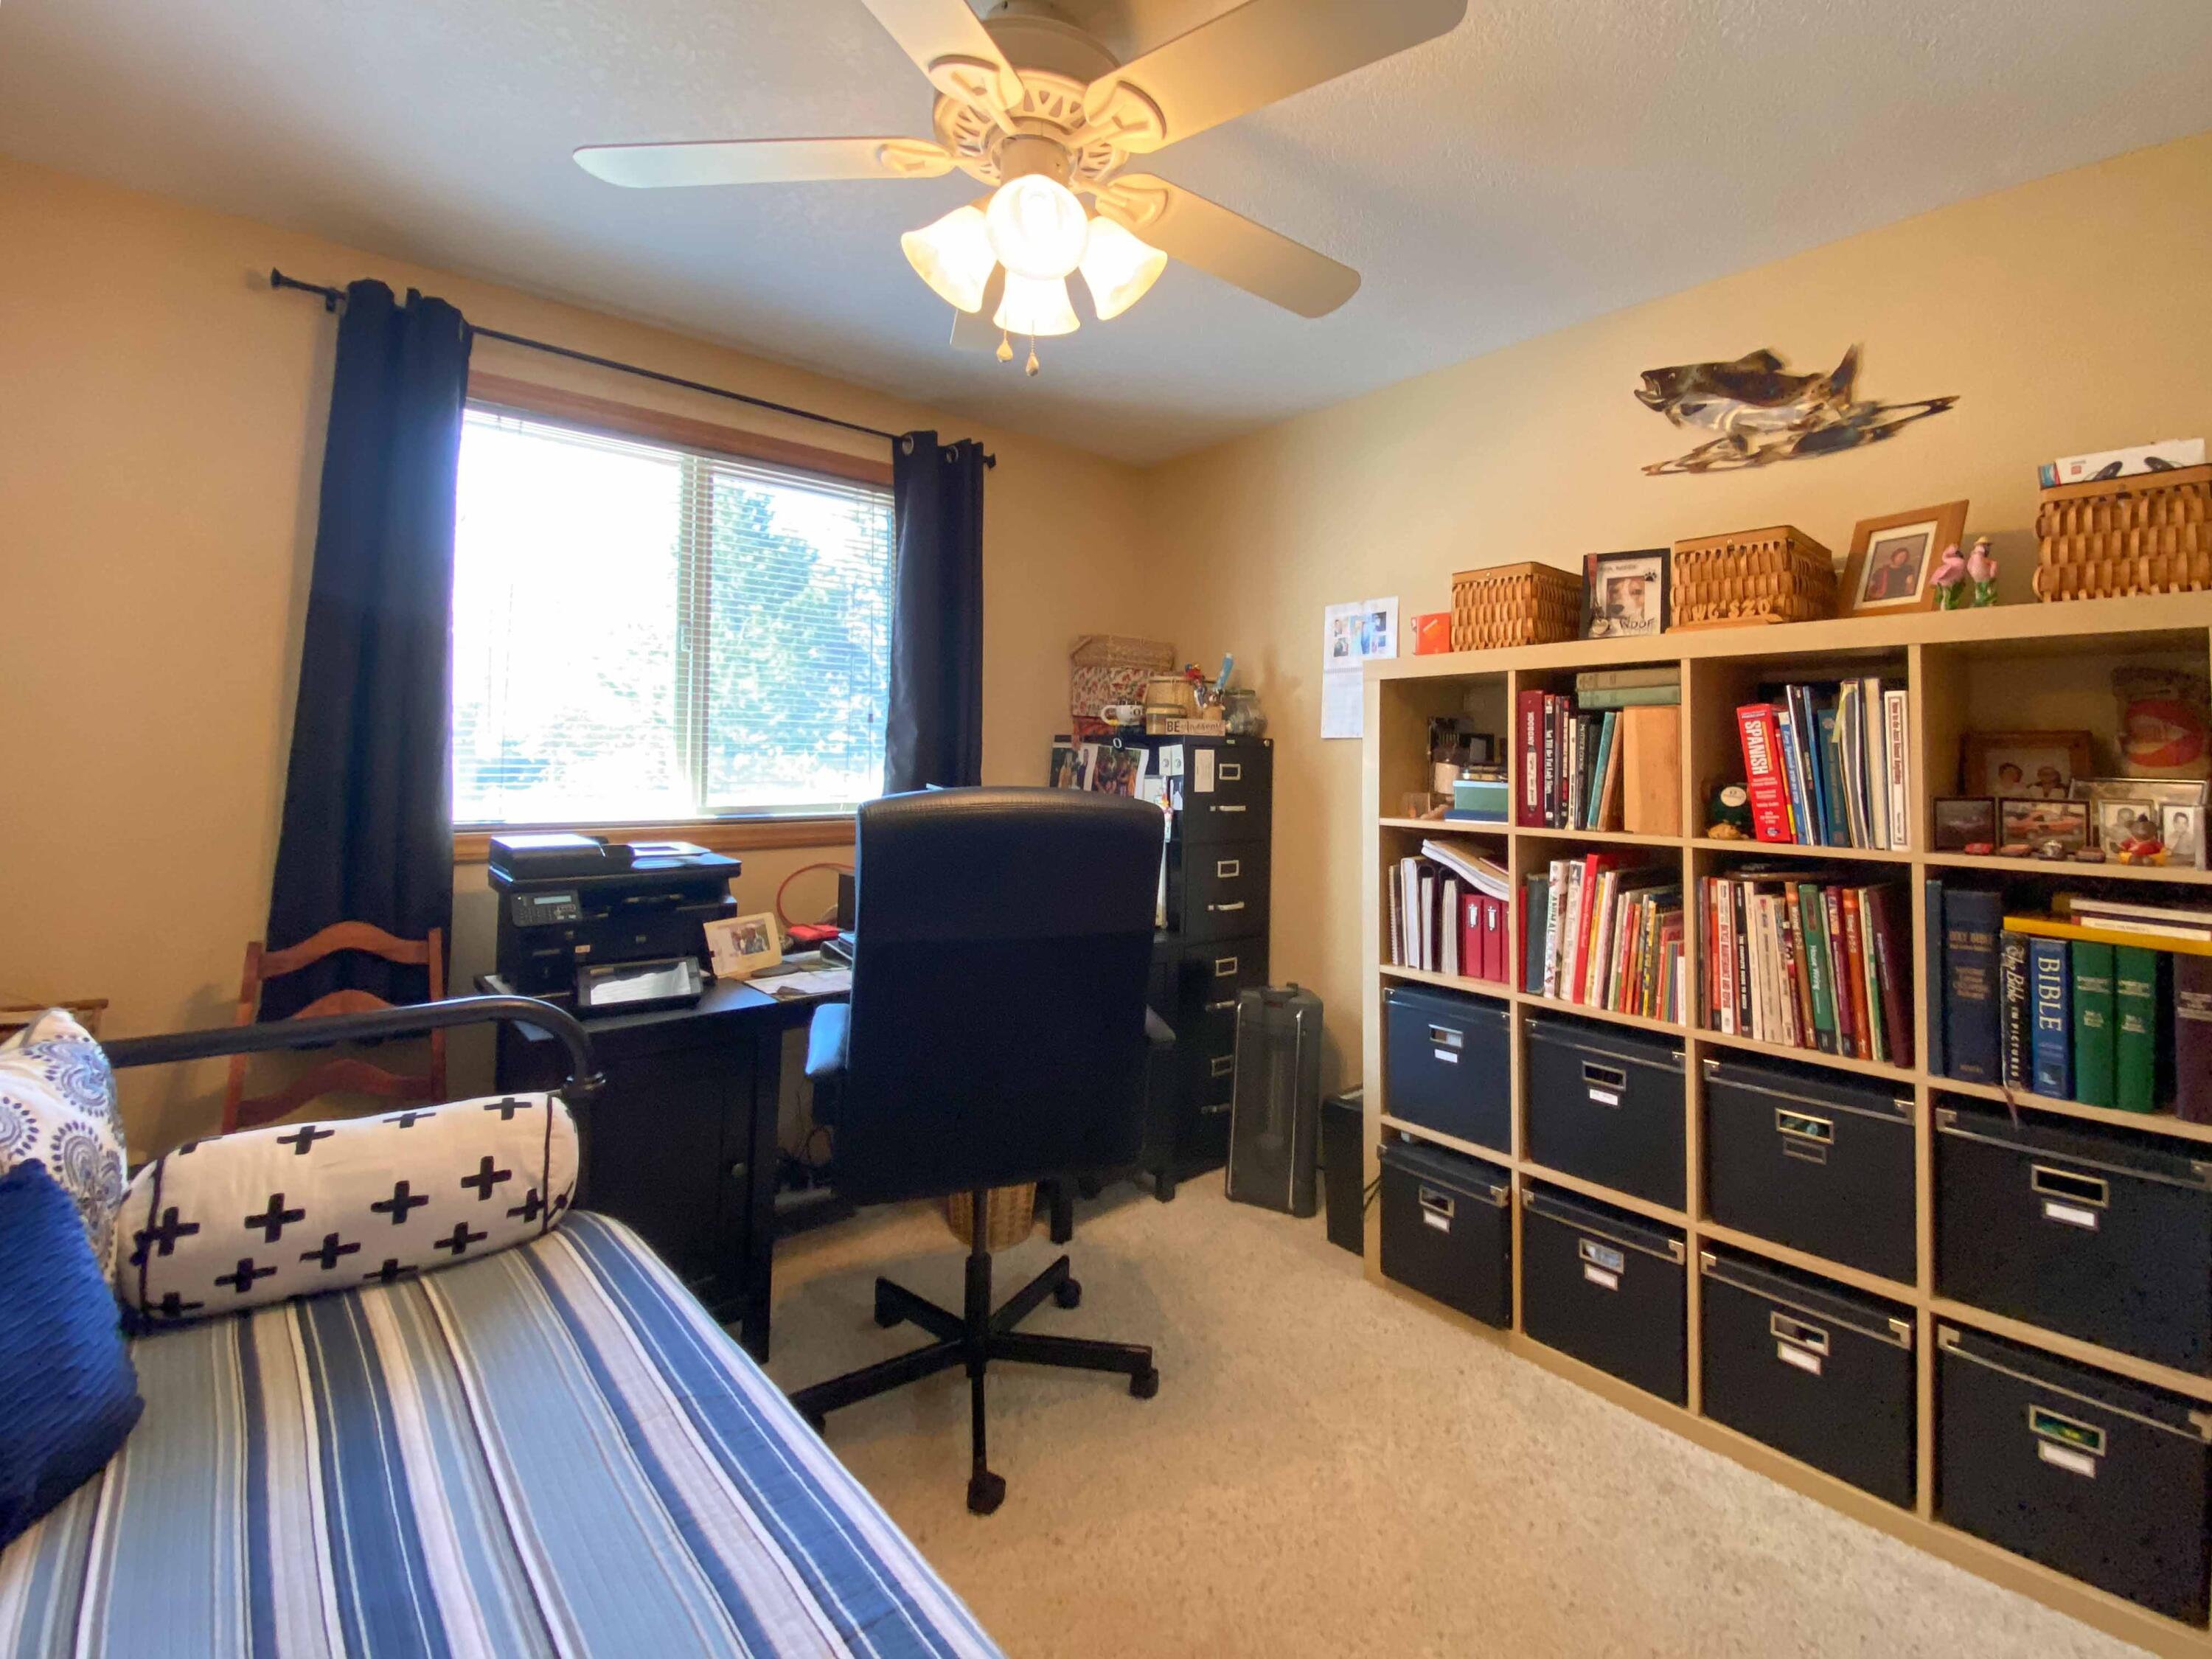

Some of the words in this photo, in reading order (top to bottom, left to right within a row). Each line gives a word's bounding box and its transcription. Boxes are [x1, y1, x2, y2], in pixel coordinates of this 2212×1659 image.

[1166, 721, 1180, 732] BE
[1527, 712, 1535, 746] ANDBOOK
[1744, 720, 1769, 775] SPANISH
[1809, 945, 1819, 967] House
[1812, 968, 1821, 990] Wiring
[2006, 970, 2025, 1004] Bible
[2038, 957, 2062, 1032] BIBLE
